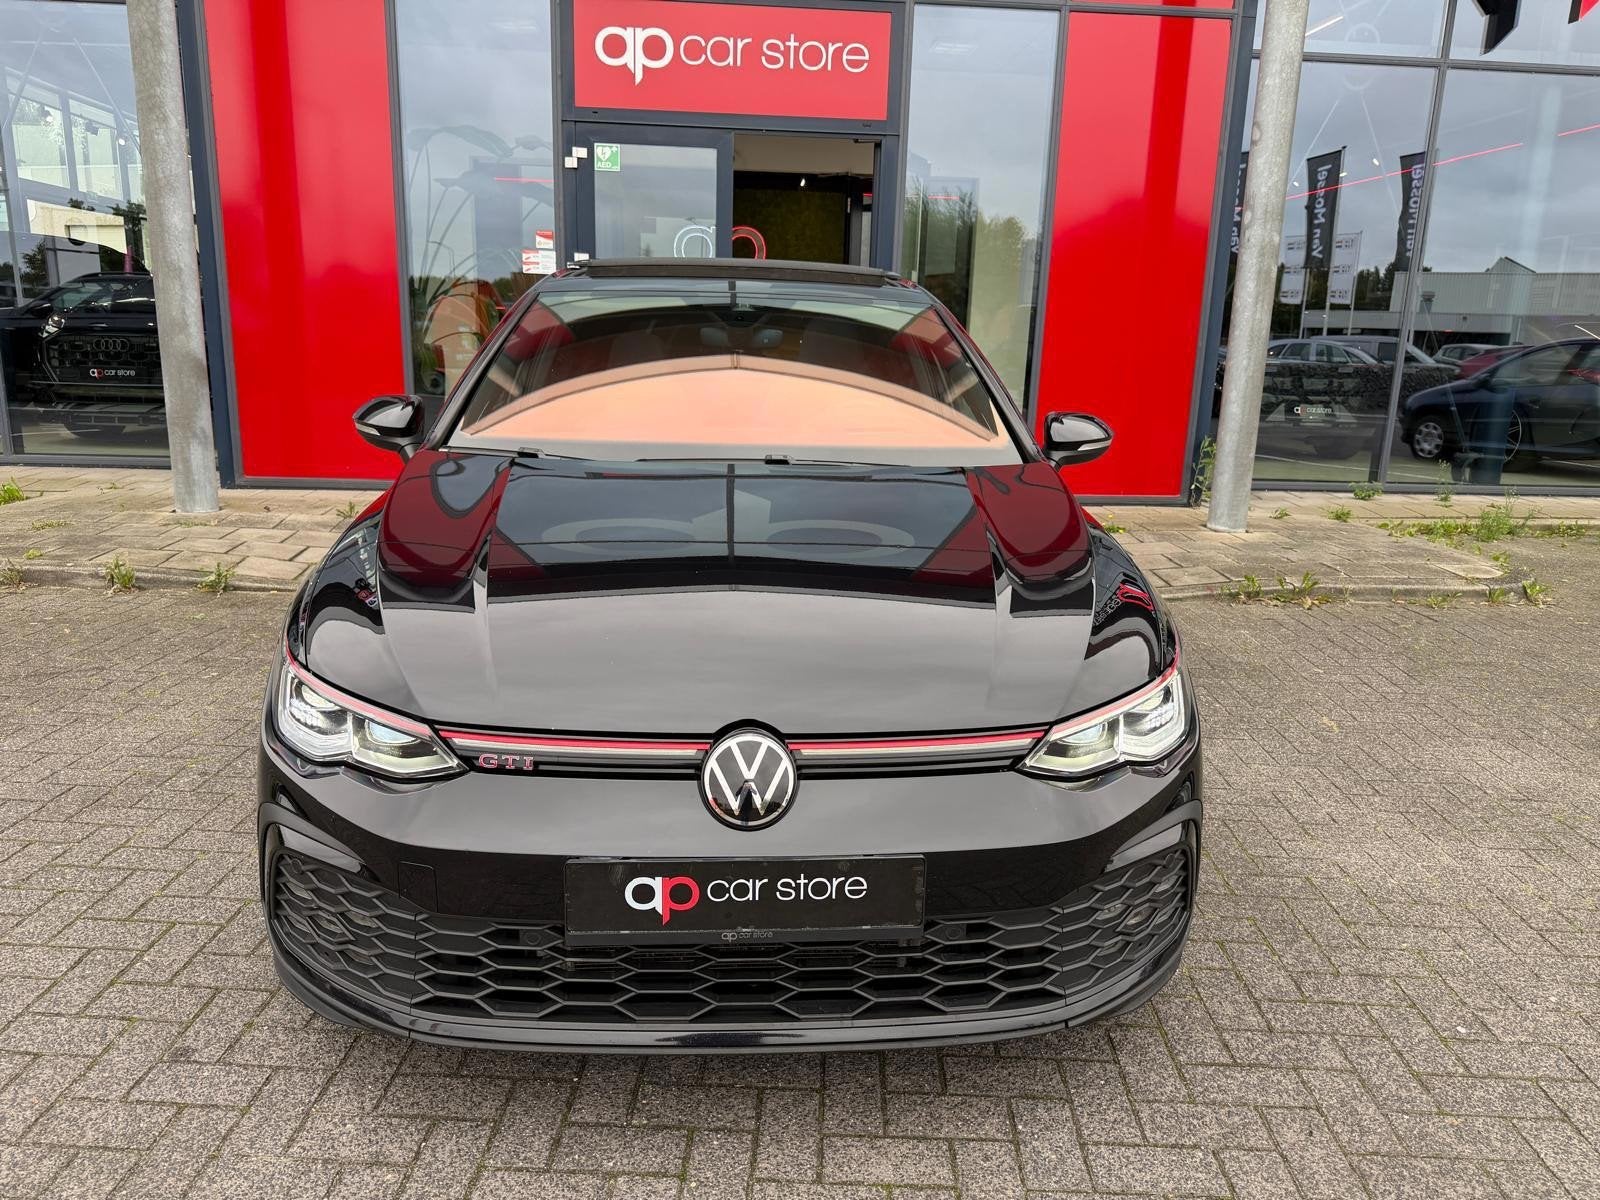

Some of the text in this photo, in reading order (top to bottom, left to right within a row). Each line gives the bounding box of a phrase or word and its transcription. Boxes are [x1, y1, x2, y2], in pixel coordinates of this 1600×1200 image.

[679, 34, 752, 67] car
[761, 33, 870, 73] store
[597, 161, 612, 169] AED
[117, 368, 136, 376] store
[479, 753, 534, 770] GTI
[707, 878, 769, 902] car
[776, 873, 868, 901] store
[739, 931, 752, 939] car
[753, 931, 774, 939] store
